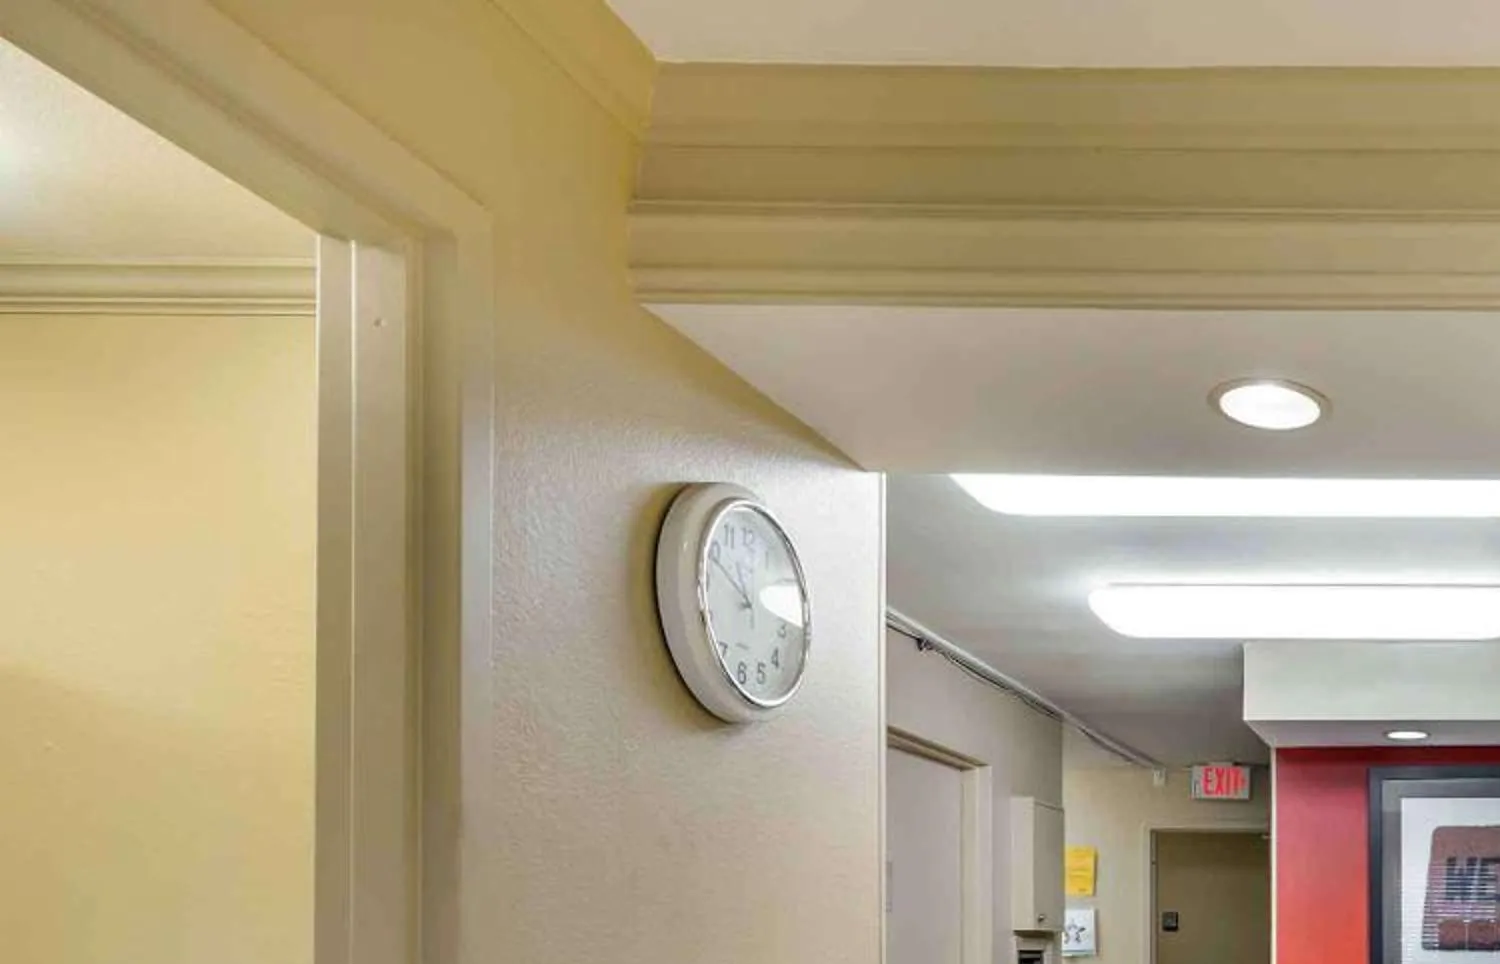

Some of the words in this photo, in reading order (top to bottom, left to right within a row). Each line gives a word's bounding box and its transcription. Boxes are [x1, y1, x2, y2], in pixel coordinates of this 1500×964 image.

[770, 647, 780, 669] 4
[737, 661, 748, 685] 6
[756, 661, 767, 685] 5
[1203, 767, 1241, 796] EXIT
